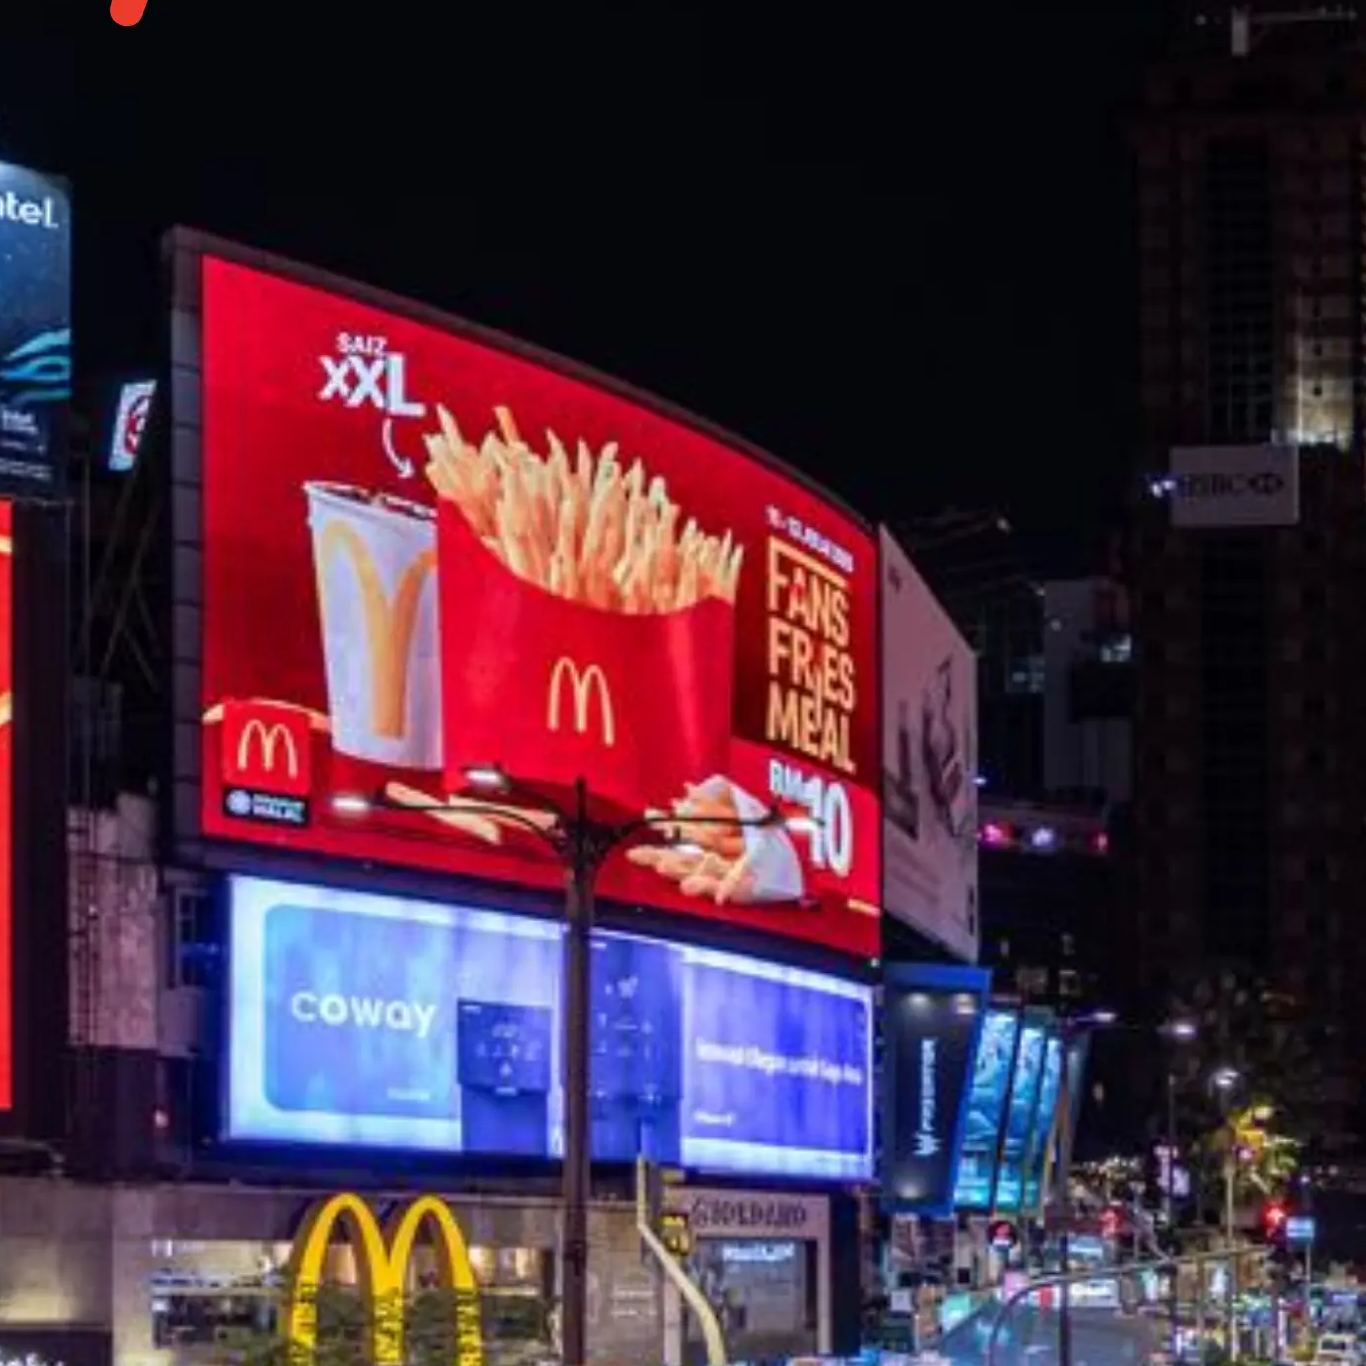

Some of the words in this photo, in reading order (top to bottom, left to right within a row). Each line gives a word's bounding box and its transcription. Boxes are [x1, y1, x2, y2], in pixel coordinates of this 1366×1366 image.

[317, 352, 426, 417] XXL
[768, 536, 850, 647] FANS
[768, 617, 855, 721] FRIES
[766, 681, 857, 774] MEAL
[290, 990, 437, 1037] coway
